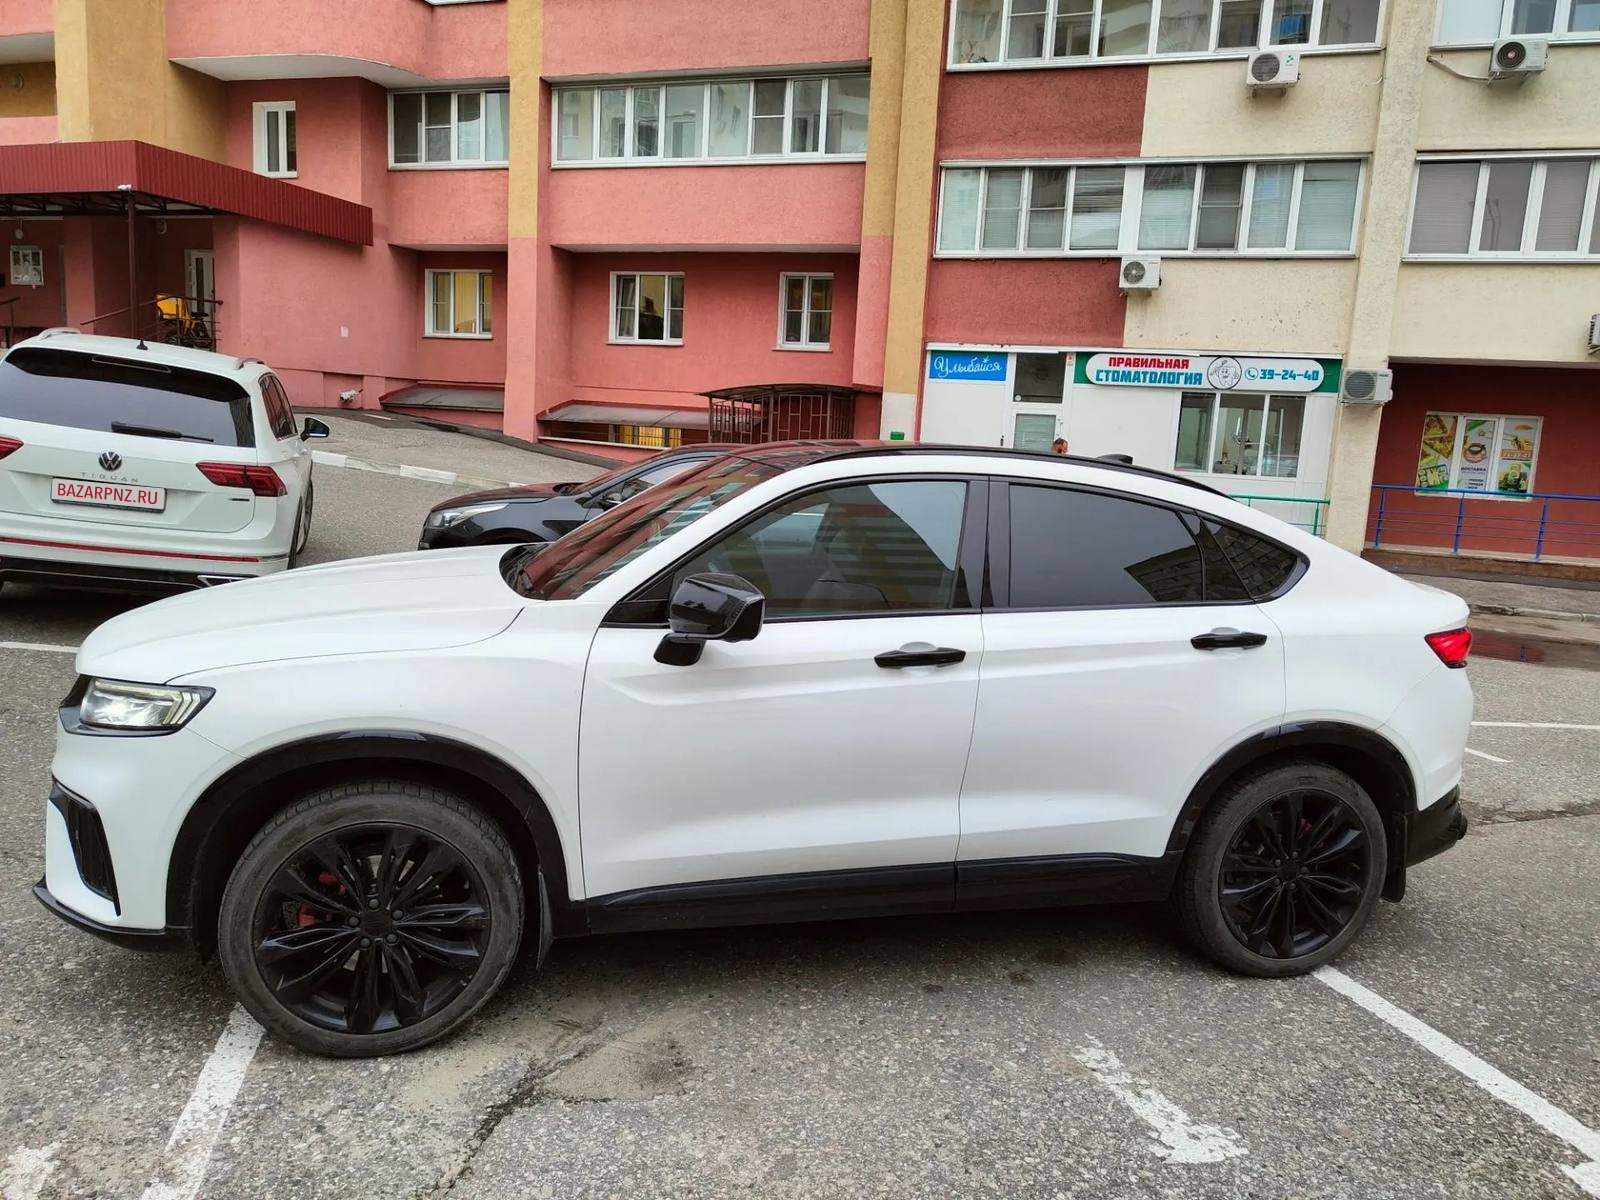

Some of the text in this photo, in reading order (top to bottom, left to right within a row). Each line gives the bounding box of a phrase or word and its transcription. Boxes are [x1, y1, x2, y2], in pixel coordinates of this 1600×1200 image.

[934, 356, 1002, 378] Улыбайся
[1109, 357, 1189, 369] ПРАВИЛЬНАЯ
[1095, 369, 1203, 385] СТОМАТОЛОГИЯ
[1259, 368, 1319, 381] 39-24-40
